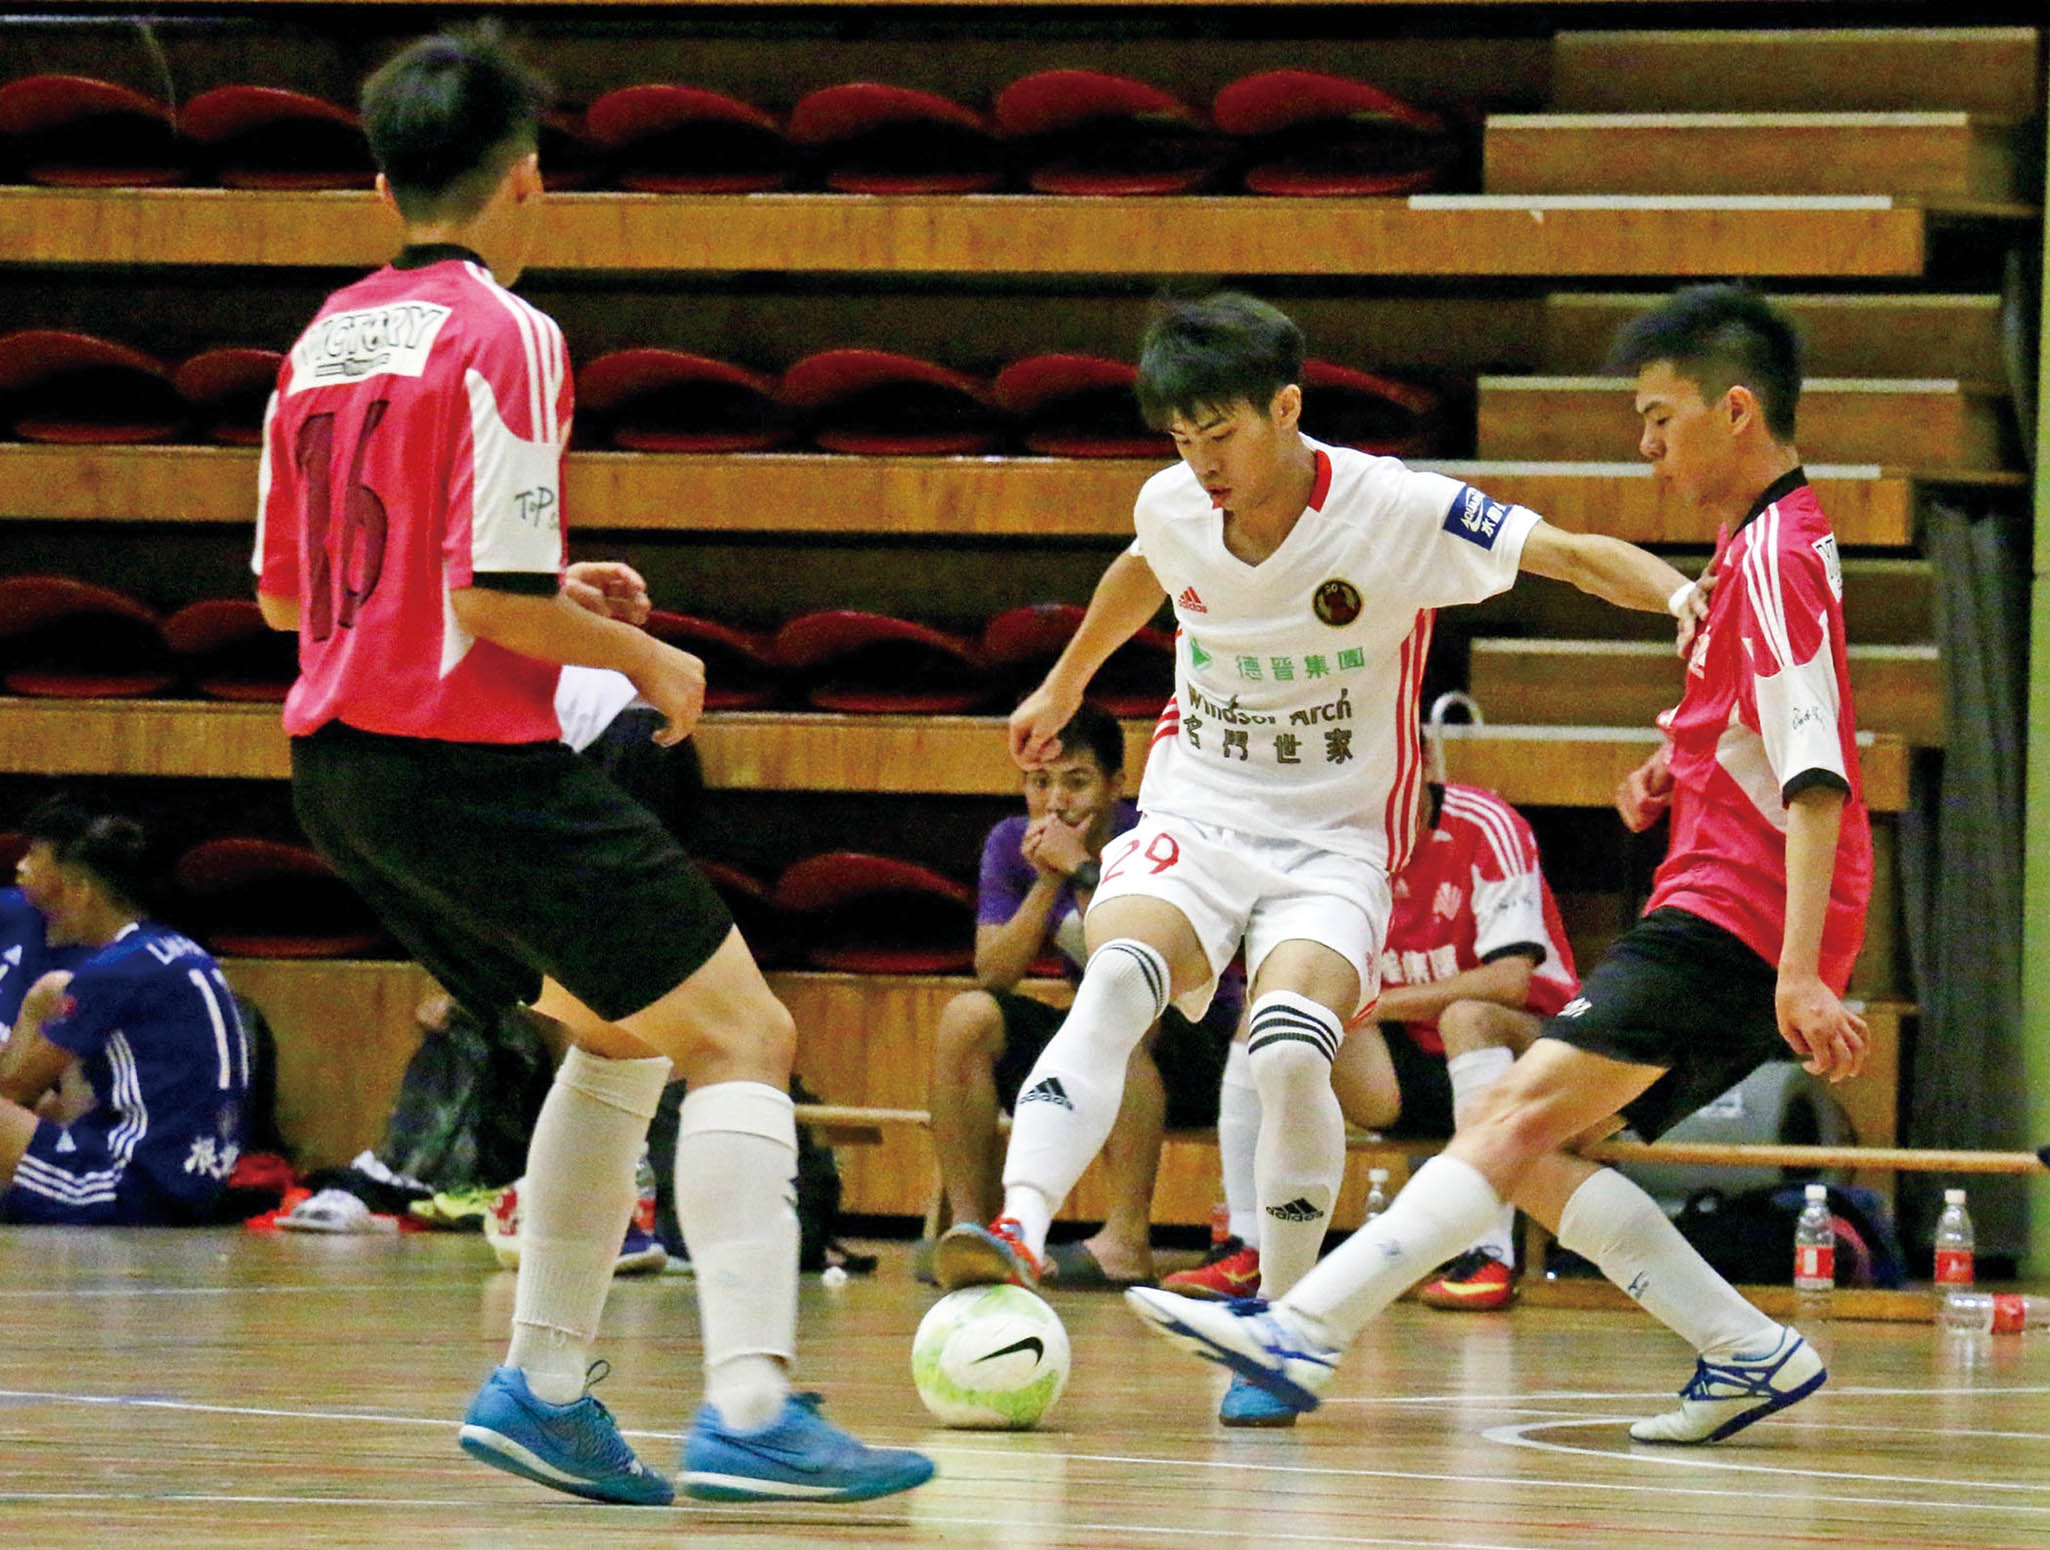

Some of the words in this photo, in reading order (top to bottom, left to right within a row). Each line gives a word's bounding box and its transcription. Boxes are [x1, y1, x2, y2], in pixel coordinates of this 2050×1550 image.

[296, 399, 389, 642] 16
[1235, 647, 1365, 681] 德晉集團
[1101, 833, 1180, 884] 29
[1265, 1206, 1324, 1222] adidas
